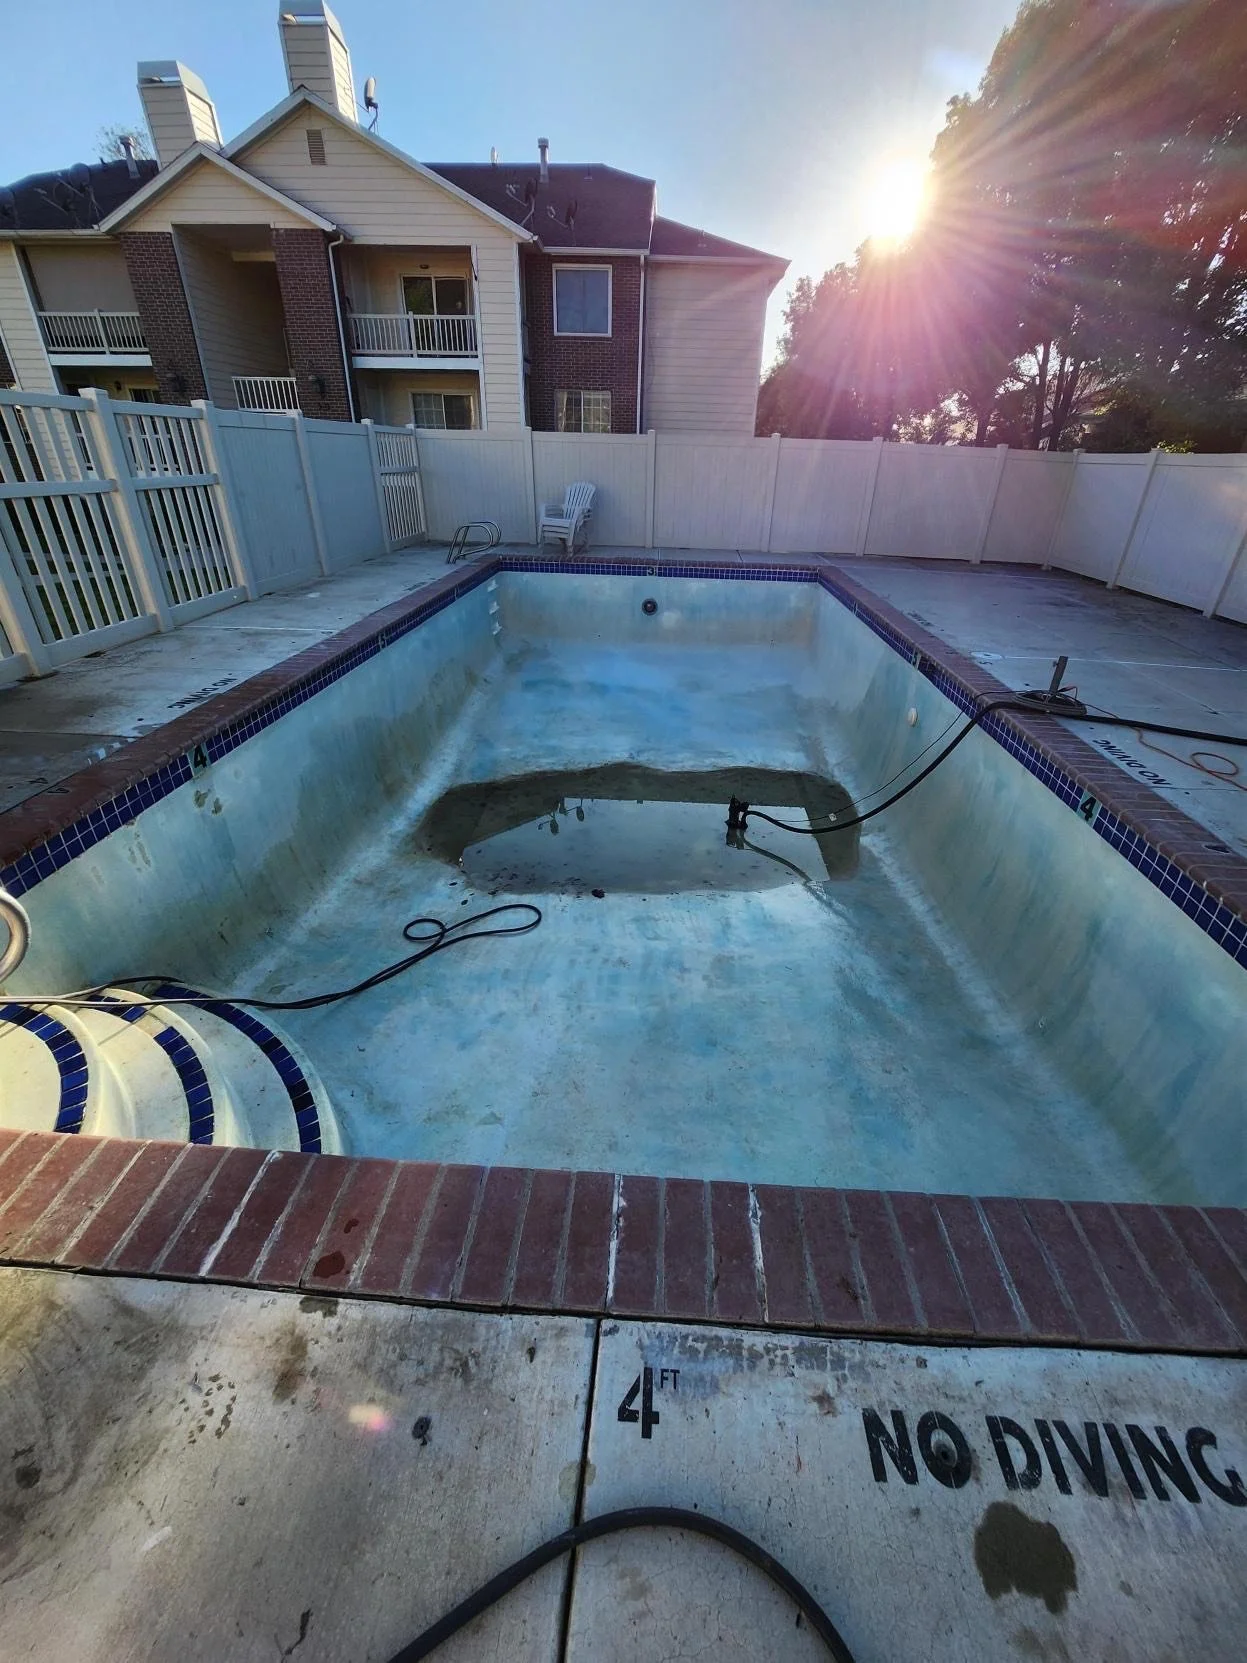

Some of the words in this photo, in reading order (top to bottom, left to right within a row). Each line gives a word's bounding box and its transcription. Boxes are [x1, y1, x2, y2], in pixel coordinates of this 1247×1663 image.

[212, 678, 238, 687] NO
[167, 687, 219, 709] DIVING
[193, 745, 208, 769] 4
[1092, 740, 1147, 769] DIVING
[1138, 770, 1172, 786] NO
[1079, 796, 1097, 822] 4
[617, 1366, 660, 1439] 4
[660, 1369, 681, 1390] FT
[861, 1407, 973, 1489] NO
[985, 1415, 1247, 1507] DIVING
